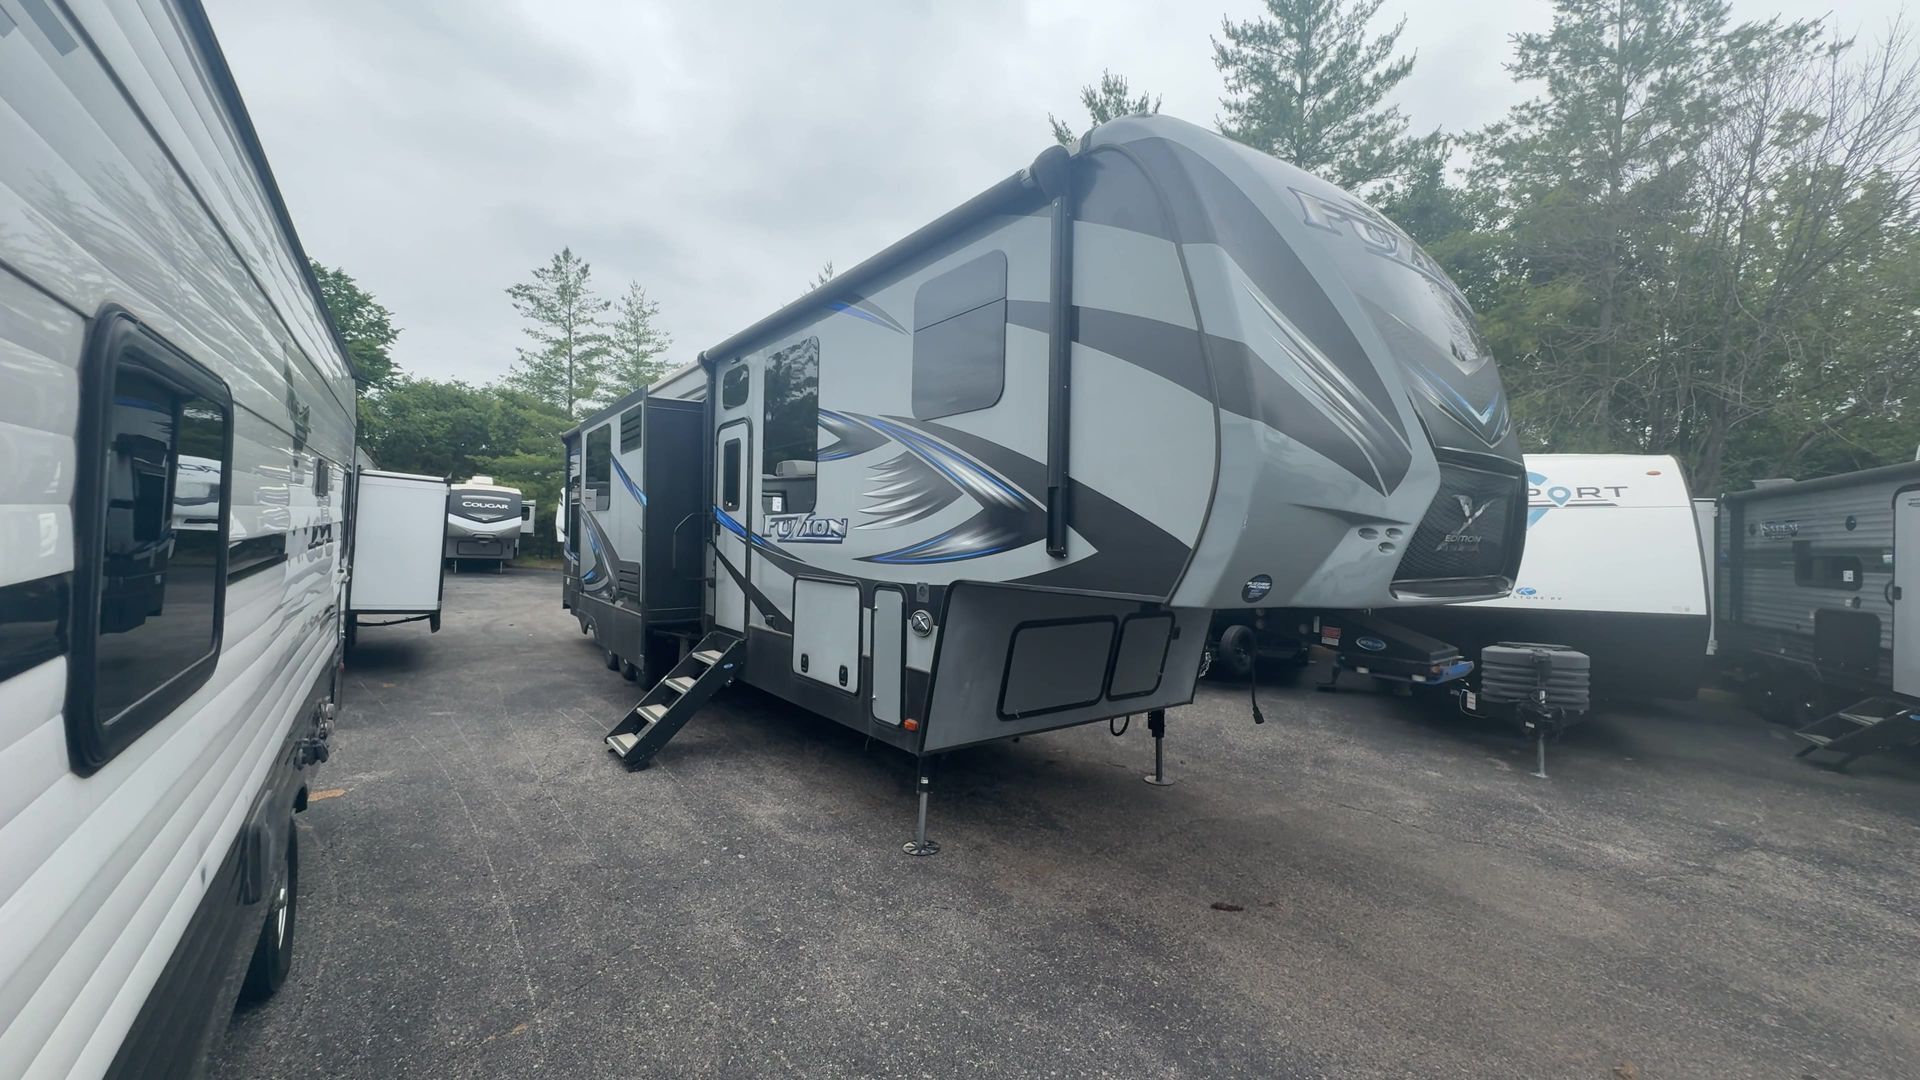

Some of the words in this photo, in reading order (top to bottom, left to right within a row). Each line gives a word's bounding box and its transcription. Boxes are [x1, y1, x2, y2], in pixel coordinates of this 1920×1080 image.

[462, 501, 509, 510] COUGAR
[761, 512, 848, 544] FUZION
[1445, 534, 1482, 543] EDITION
